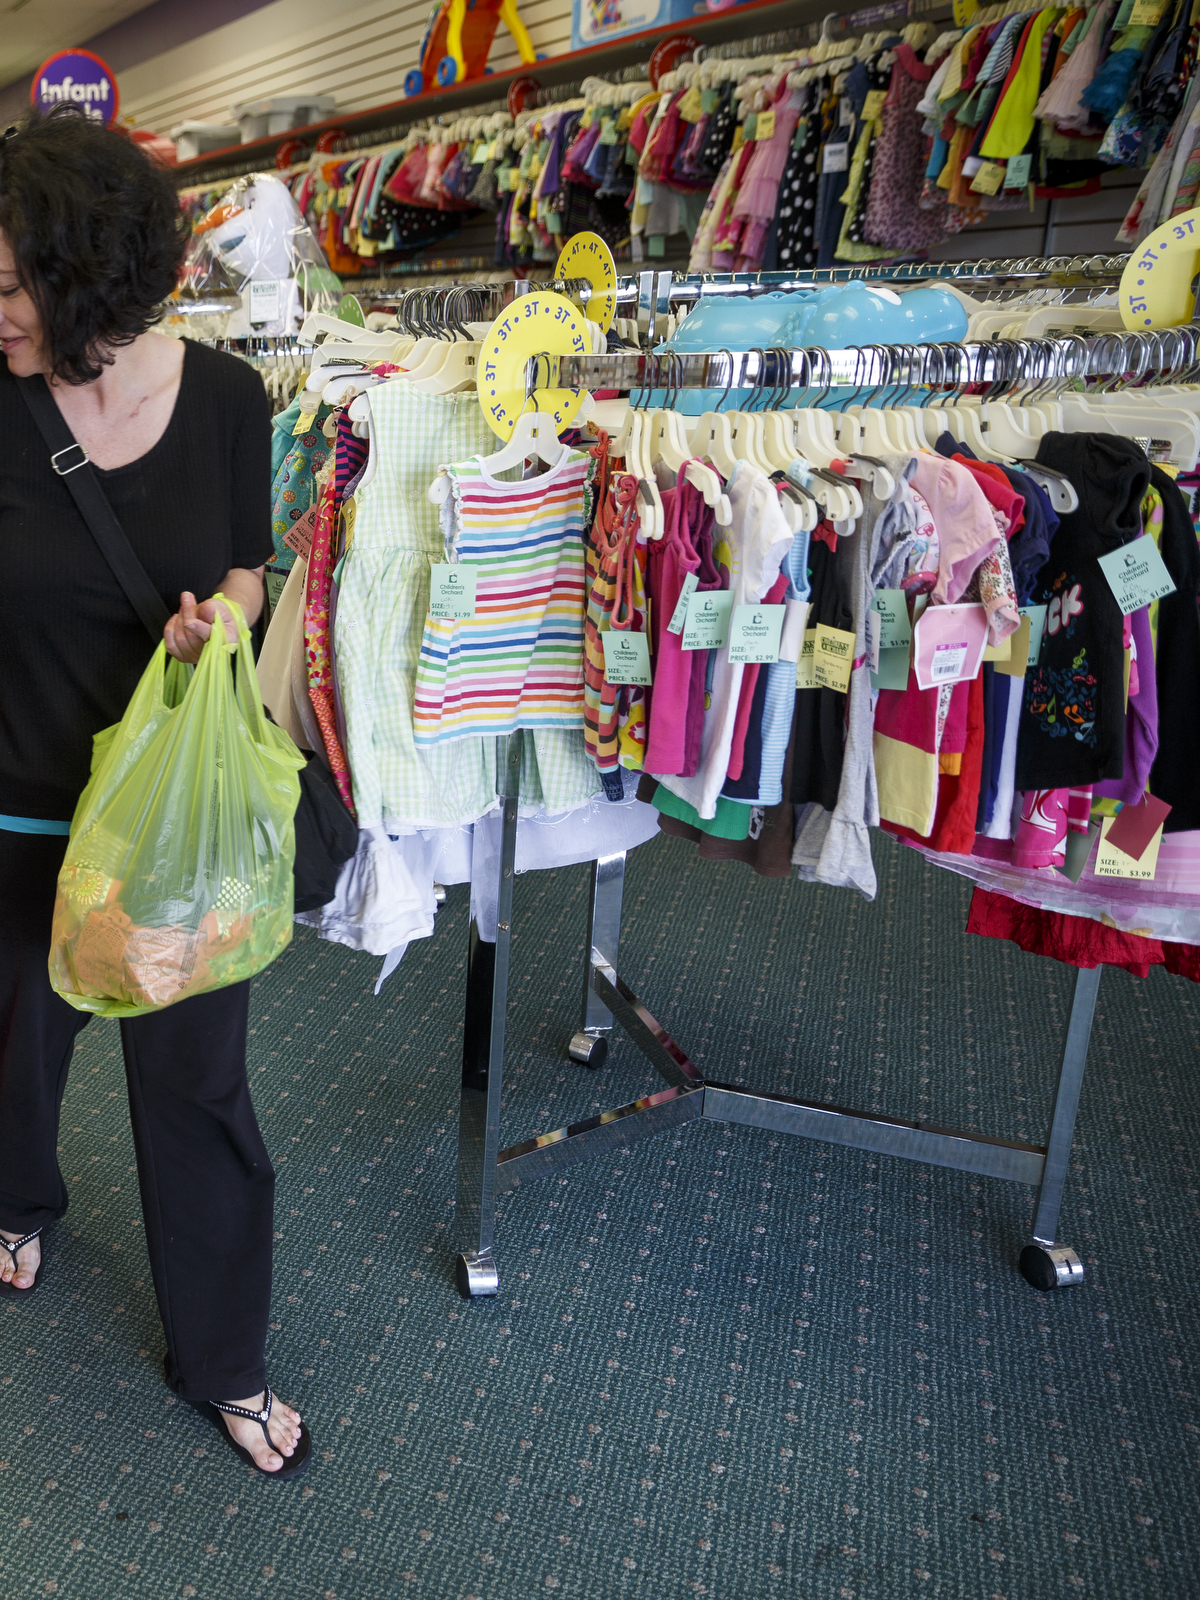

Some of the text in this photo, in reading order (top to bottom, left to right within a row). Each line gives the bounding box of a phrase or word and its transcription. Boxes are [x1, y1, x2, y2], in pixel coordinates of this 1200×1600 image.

[40, 76, 111, 103] Infant
[572, 241, 580, 255] 4T
[588, 241, 599, 254] 4T
[603, 262, 612, 276] 4T
[1128, 218, 1196, 315] 3T 3T 3T
[524, 301, 540, 318] 3T
[605, 294, 613, 312] 4T
[554, 306, 571, 324] 3T
[497, 318, 513, 341] 3T
[572, 334, 585, 353] 3T
[485, 361, 497, 381] 3T
[490, 402, 506, 422] 3T
[1118, 561, 1149, 579] Children's
[1122, 567, 1149, 584] Orchard
[1119, 592, 1137, 605] SIZE:
[1123, 598, 1147, 613] PRICE:
[1150, 584, 1170, 599] $1.99
[706, 639, 723, 647] $2.99
[890, 639, 910, 647] $1.99
[815, 665, 826, 674] SIZE:
[814, 673, 847, 689] PRICE: $2.99
[1099, 868, 1124, 876] PRICE:
